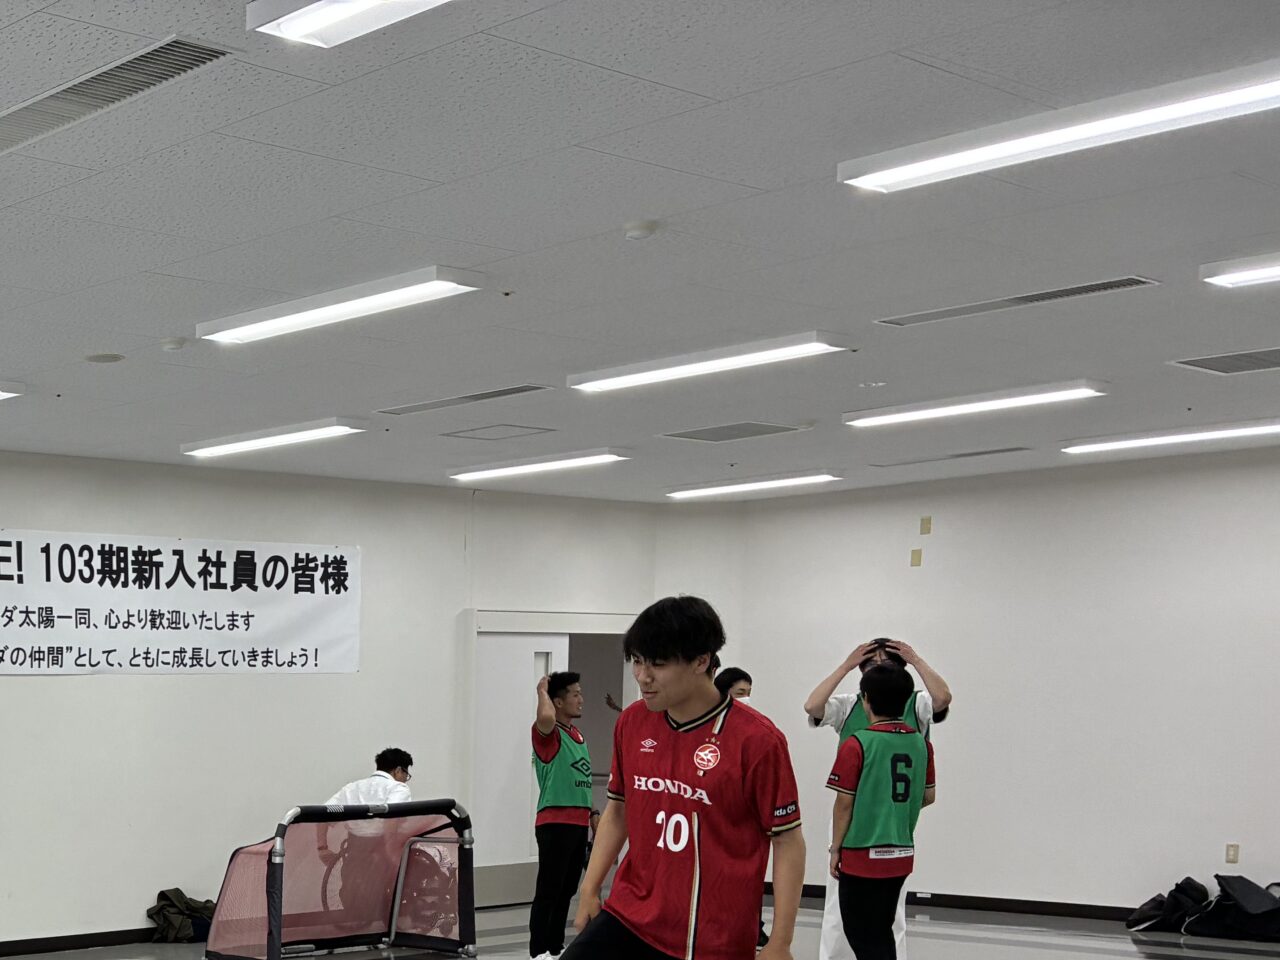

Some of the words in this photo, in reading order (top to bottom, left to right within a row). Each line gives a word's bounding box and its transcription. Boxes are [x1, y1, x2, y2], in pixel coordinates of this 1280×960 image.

[40, 543, 349, 595] 103期新入社員の皆様
[633, 775, 713, 805] HONDA
[890, 753, 913, 803] 6
